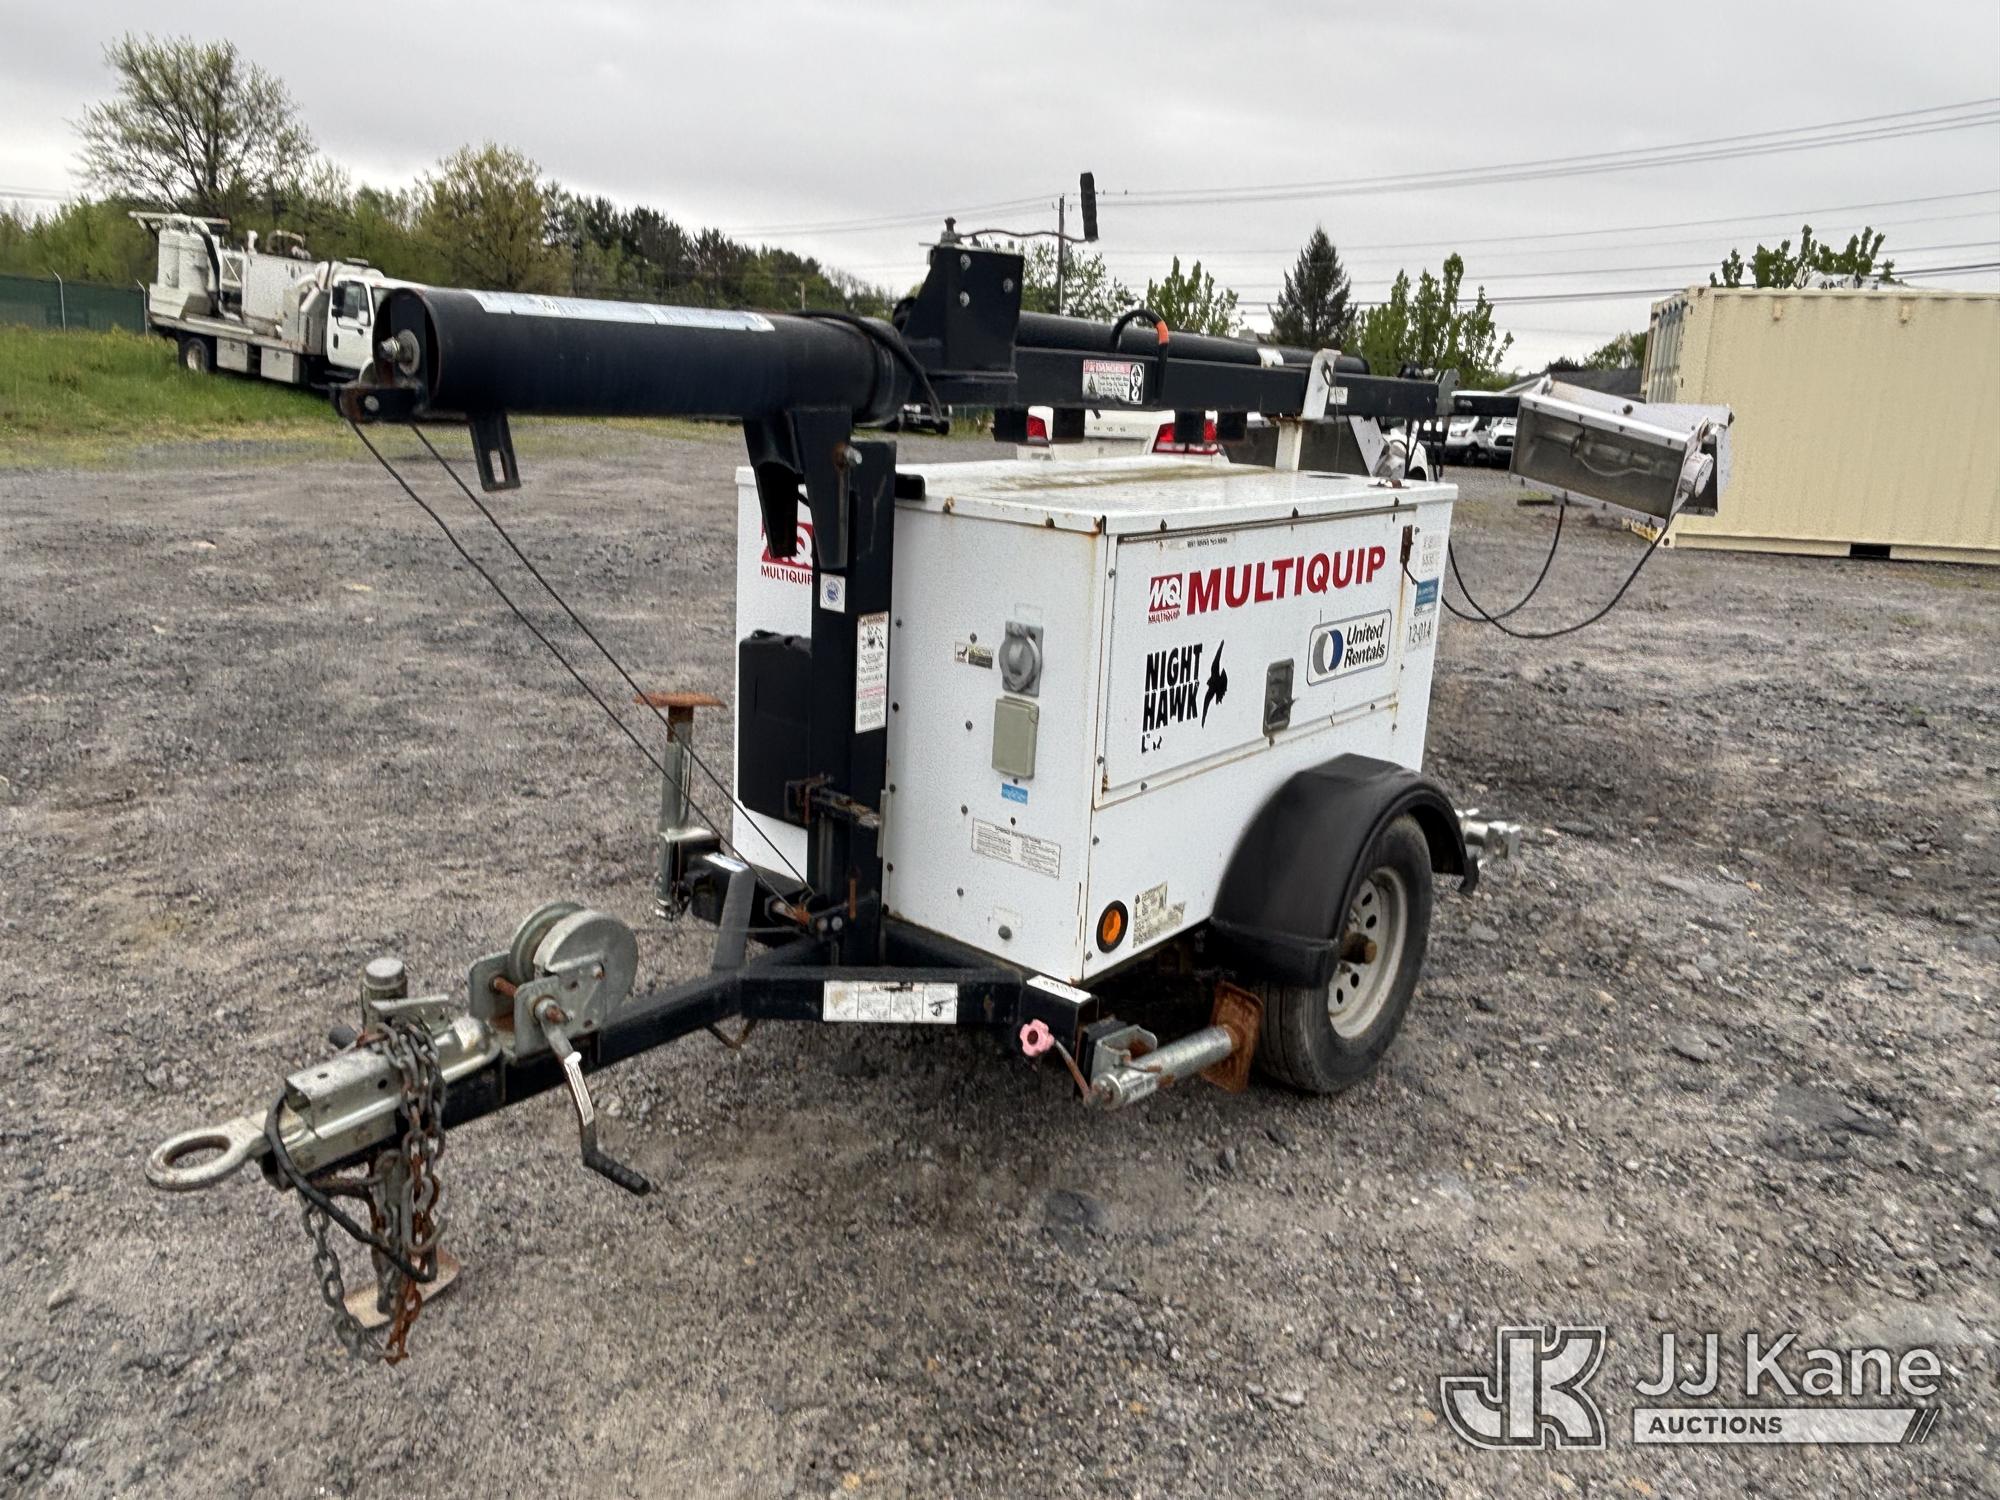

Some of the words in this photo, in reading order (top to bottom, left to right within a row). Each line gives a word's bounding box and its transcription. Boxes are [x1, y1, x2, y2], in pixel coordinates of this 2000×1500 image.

[1149, 575, 1182, 610] MQ
[1186, 546, 1386, 616] MULTIQUIP
[1346, 618, 1385, 646] United
[1145, 643, 1203, 692] NIGHT
[1344, 643, 1386, 669] Rentals
[1142, 681, 1200, 733] HAWK
